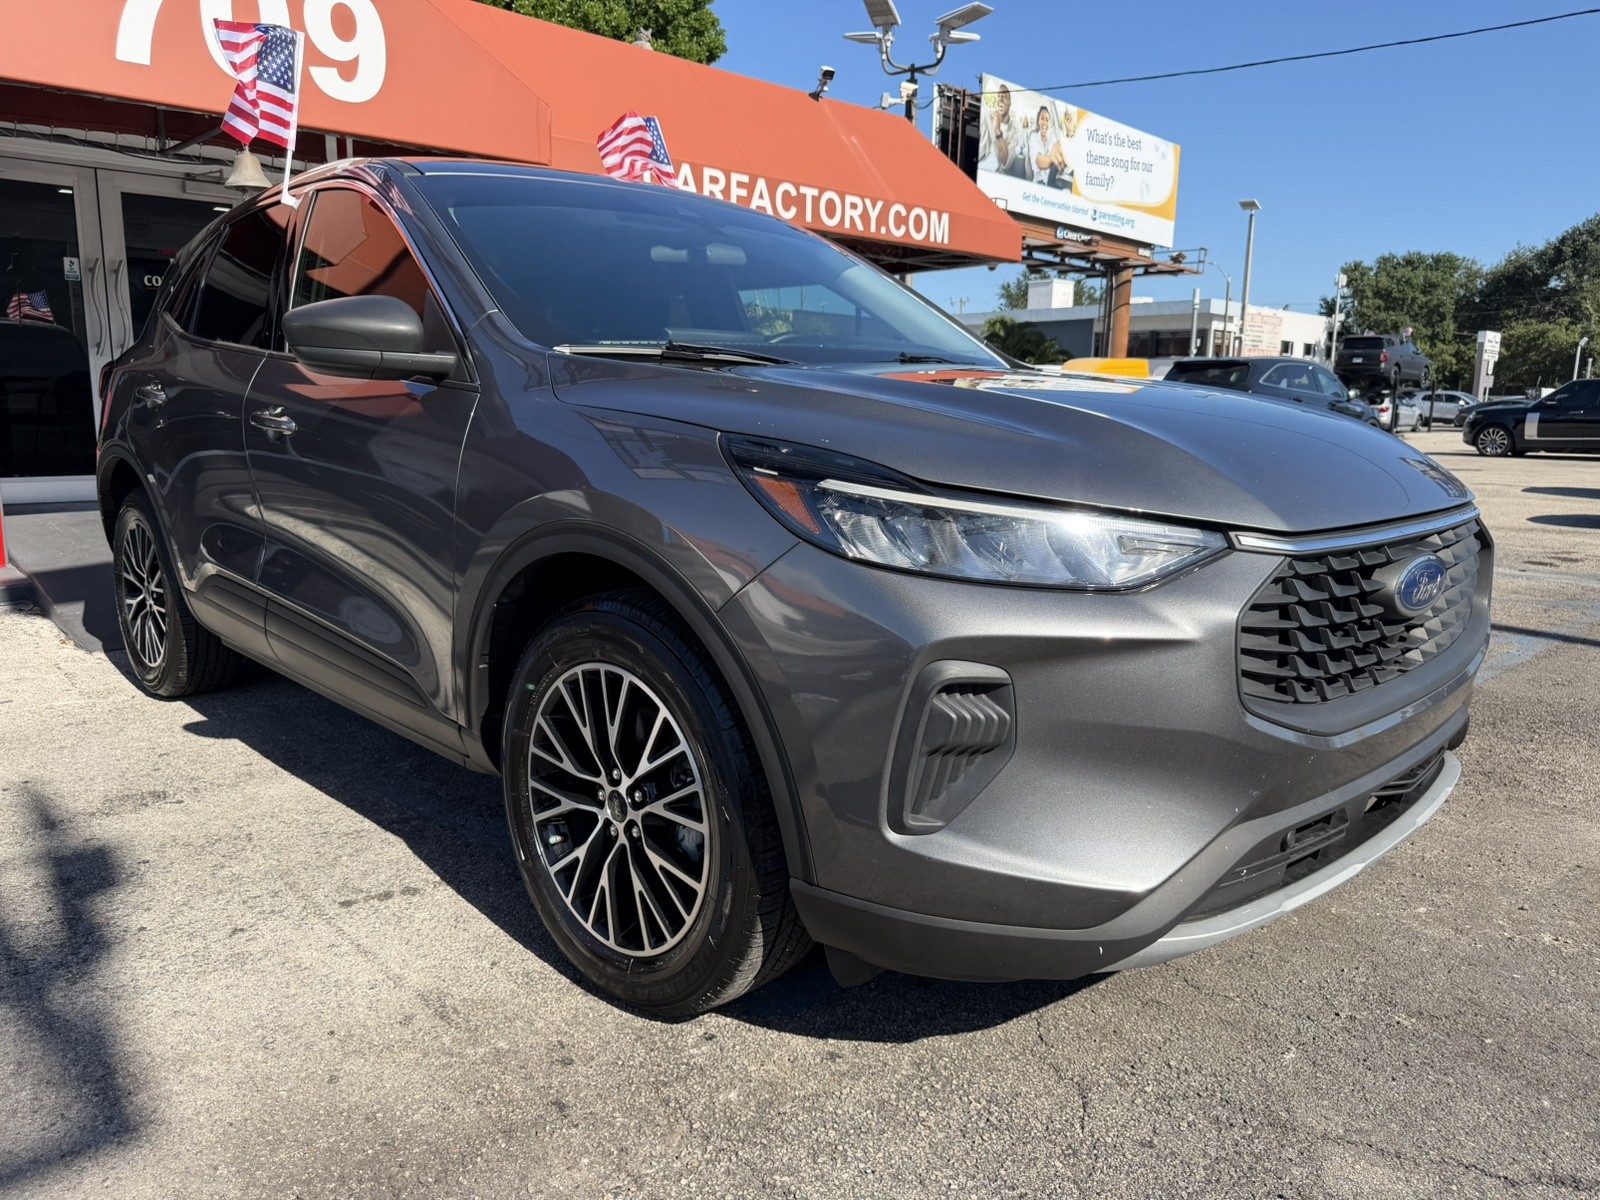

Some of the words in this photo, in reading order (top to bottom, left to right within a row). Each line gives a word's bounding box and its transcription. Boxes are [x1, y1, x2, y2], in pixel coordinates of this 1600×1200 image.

[1087, 128, 1112, 146] What's
[1114, 133, 1125, 148] the
[1127, 136, 1142, 150] best
[1086, 150, 1110, 166] theme
[1111, 157, 1129, 172] song
[1130, 157, 1140, 171] for
[1142, 163, 1154, 173] our
[1086, 172, 1114, 191] family?
[643, 162, 949, 244] ARFACTORY.COM
[1022, 192, 1031, 201] Get
[1032, 194, 1040, 204] the
[1098, 210, 1135, 228] parenting.org
[144, 274, 164, 287] CO
[1412, 568, 1440, 603] Ford
